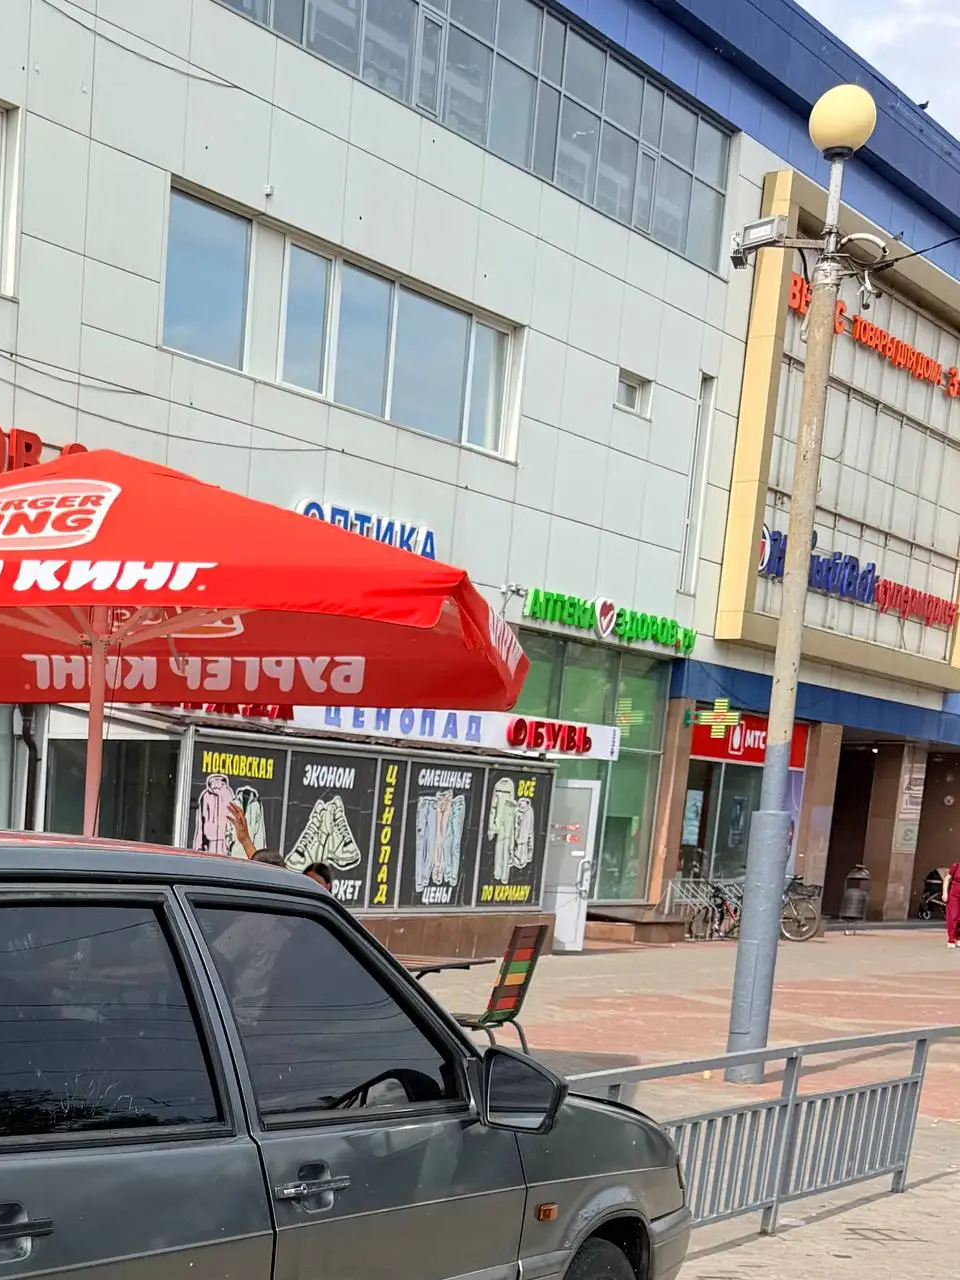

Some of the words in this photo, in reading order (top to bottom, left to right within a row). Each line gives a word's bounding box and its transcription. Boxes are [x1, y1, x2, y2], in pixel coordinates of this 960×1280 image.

[852, 314, 898, 359] ТОВАРЫ
[896, 341, 917, 370] ДЛЯ
[915, 351, 943, 386] ДОМА
[12, 559, 219, 592] КИНГ
[524, 588, 597, 629] АПТЕКА
[324, 704, 482, 743] ЦЕНОПАД
[506, 717, 593, 755] ОБУВЬ
[744, 729, 767, 750] МТС
[202, 751, 274, 780] МОСКОВСКАЯ
[302, 764, 356, 789] ЭКОНОМ
[418, 768, 473, 789] СМЕШНЫЕ
[517, 778, 537, 797] ВСЁ
[374, 764, 399, 905] ЦЕНОПАД
[331, 879, 362, 901] РКЕТ
[421, 886, 453, 904] ЦЕНЫ
[481, 885, 494, 901] ПО
